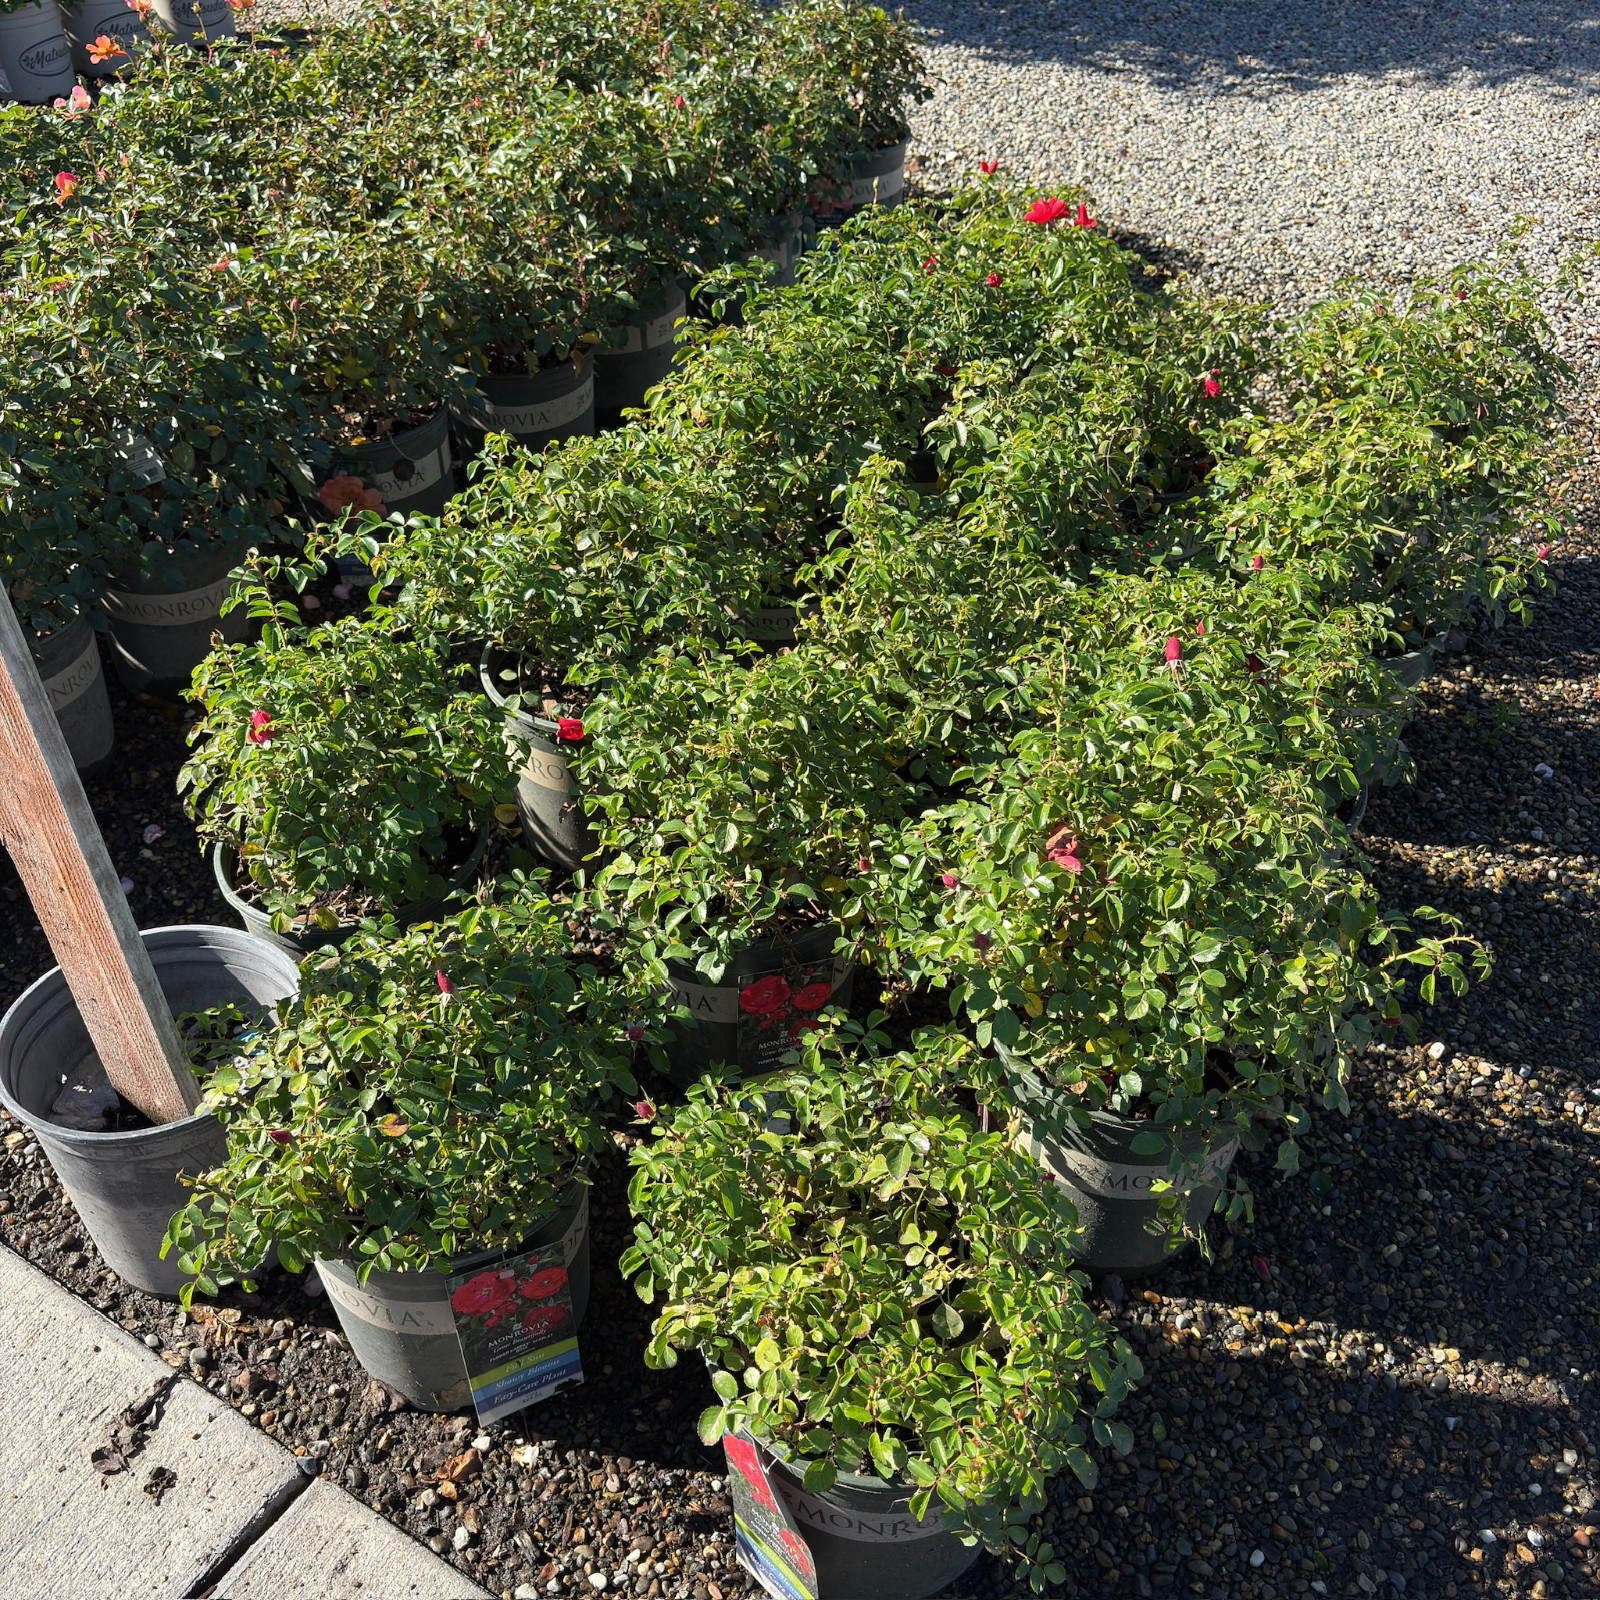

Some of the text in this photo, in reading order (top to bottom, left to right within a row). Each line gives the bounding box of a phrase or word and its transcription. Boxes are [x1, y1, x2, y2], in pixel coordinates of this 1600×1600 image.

[122, 588, 227, 619] MONROVI
[488, 1320, 550, 1348] MONROVIA
[526, 1352, 545, 1363] Sun
[494, 1380, 540, 1404] Easy-Care
[541, 1369, 567, 1384] Plant
[495, 1359, 560, 1391] Showy Blooms
[797, 1499, 939, 1537] MONRO
